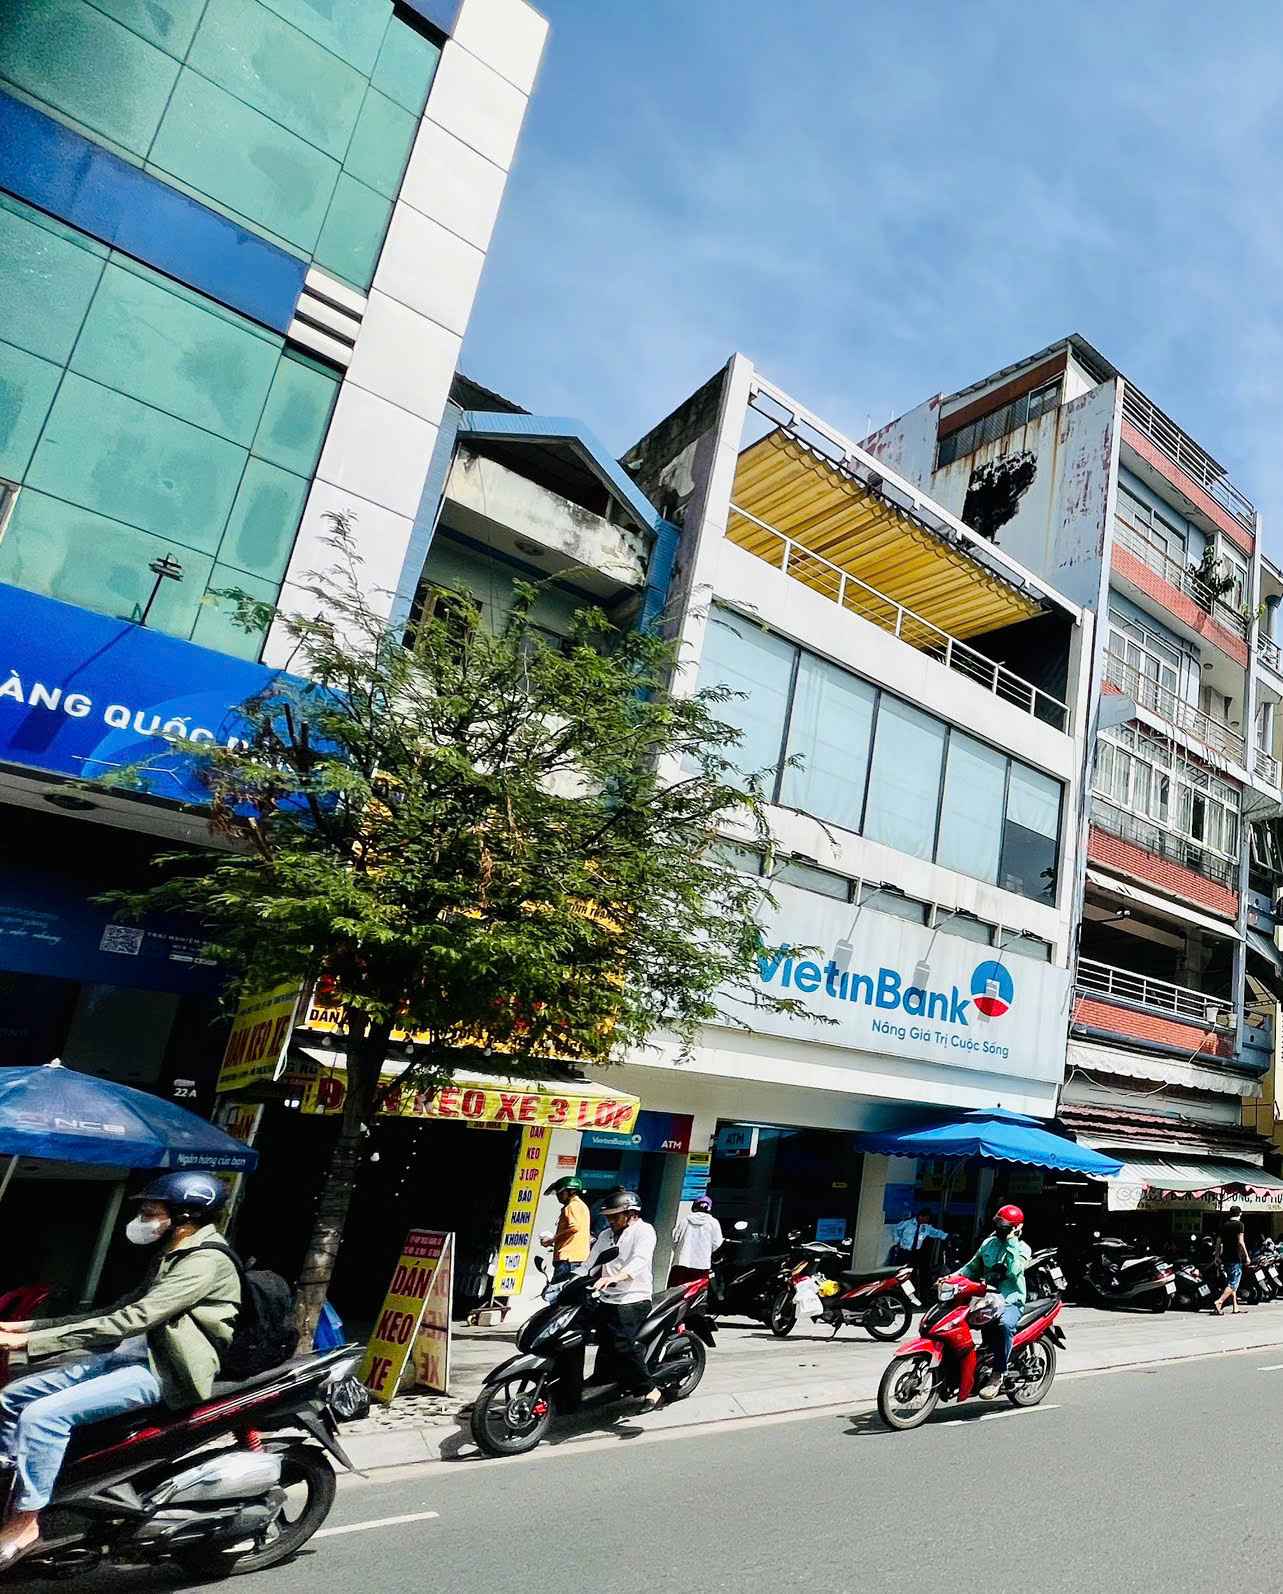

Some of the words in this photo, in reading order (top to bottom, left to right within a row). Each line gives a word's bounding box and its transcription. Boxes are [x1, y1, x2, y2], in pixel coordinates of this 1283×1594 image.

[757, 942, 971, 1027] VietinBank
[872, 1019, 906, 1040] Nâng
[910, 1025, 931, 1042] Giá
[934, 1032, 948, 1049] Trị
[951, 1035, 980, 1054] Cuộc
[982, 1040, 1009, 1059] Sống
[54, 1118, 126, 1136] NCB
[495, 1093, 540, 1123] XE
[548, 1098, 569, 1125] 3
[577, 1098, 633, 1130] LỚP
[525, 1147, 541, 1160] KEO
[661, 1140, 682, 1149] ATM
[725, 1133, 745, 1145] ATM
[519, 1168, 525, 1181] 3
[390, 1260, 433, 1299] DÁN
[376, 1308, 415, 1345] KEO
[364, 1355, 393, 1391] XE
